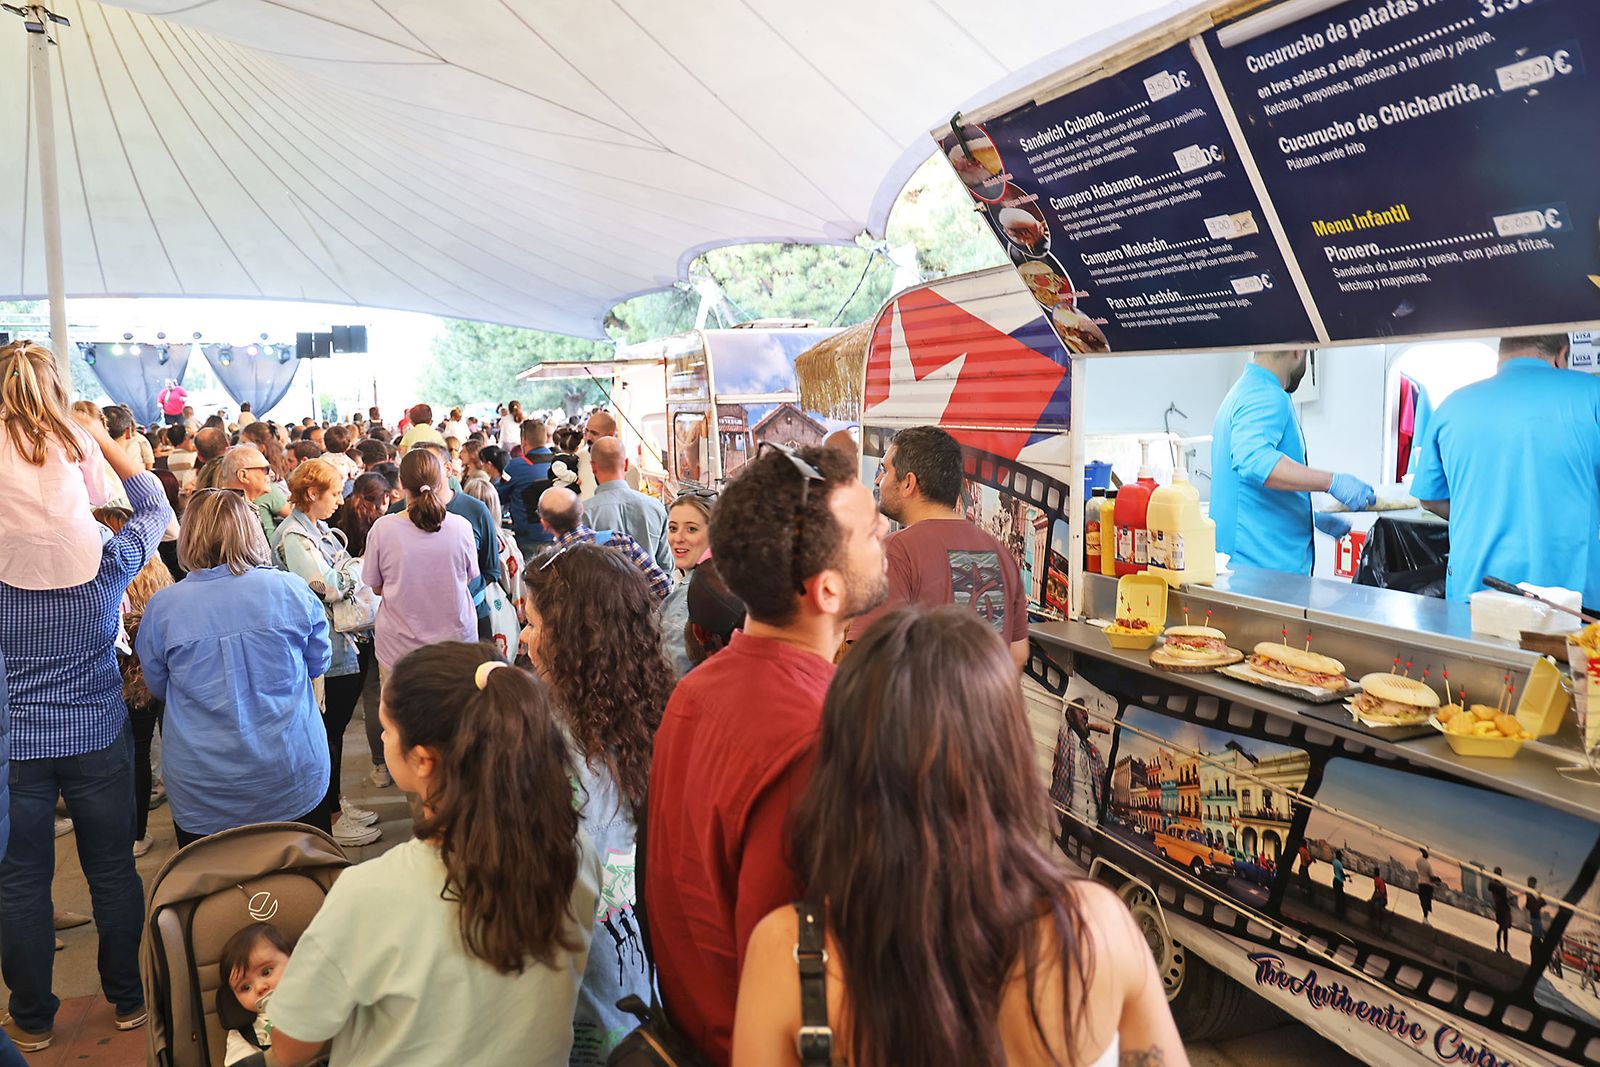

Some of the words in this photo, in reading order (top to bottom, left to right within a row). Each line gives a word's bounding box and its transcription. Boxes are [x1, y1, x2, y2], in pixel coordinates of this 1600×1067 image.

[1246, 33, 1324, 73] Cucurucho
[1326, 23, 1348, 43] de
[1349, 0, 1418, 39] patatas
[1258, 86, 1272, 99] en
[1270, 79, 1292, 94] tres
[1292, 66, 1328, 87] salsas
[1328, 63, 1337, 74] a
[1264, 98, 1303, 116] Ketchup,
[1302, 81, 1354, 104] mayonesa,
[1353, 64, 1398, 87] mostaza
[1398, 61, 1407, 72] a
[1406, 56, 1420, 69] la
[1420, 44, 1446, 64] miel
[1446, 44, 1454, 58] y
[1102, 129, 1111, 137] de
[1126, 119, 1133, 128] al
[1144, 121, 1171, 135] mostaza
[1170, 119, 1175, 128] y
[1279, 121, 1355, 153] Cucurucho
[1357, 113, 1378, 132] de
[1020, 124, 1066, 152] Sandwich
[1093, 157, 1104, 166] con
[1286, 155, 1320, 171] Plátano
[1319, 147, 1346, 162] verde
[1345, 143, 1366, 156] frito
[1184, 176, 1204, 188] queso
[1050, 191, 1092, 210] Campero
[1133, 205, 1145, 215] pan
[1144, 199, 1170, 211] campero
[1312, 219, 1354, 237] Menu
[1352, 204, 1410, 229] infantil
[1081, 249, 1124, 265] Campero
[1332, 263, 1375, 278] Sandwich
[1375, 262, 1388, 272] de
[1388, 257, 1420, 271] Jamón
[1419, 257, 1426, 268] y
[1427, 252, 1463, 267] queso,
[1463, 249, 1484, 260] con
[1484, 243, 1518, 259] patas
[1517, 238, 1554, 252] fritas,
[1338, 280, 1374, 292] ketchup
[1374, 280, 1380, 290] y
[1380, 273, 1431, 287] mayonesa.
[1106, 298, 1127, 309] Pan
[1126, 296, 1146, 307] con
[1575, 332, 1592, 340] VISA
